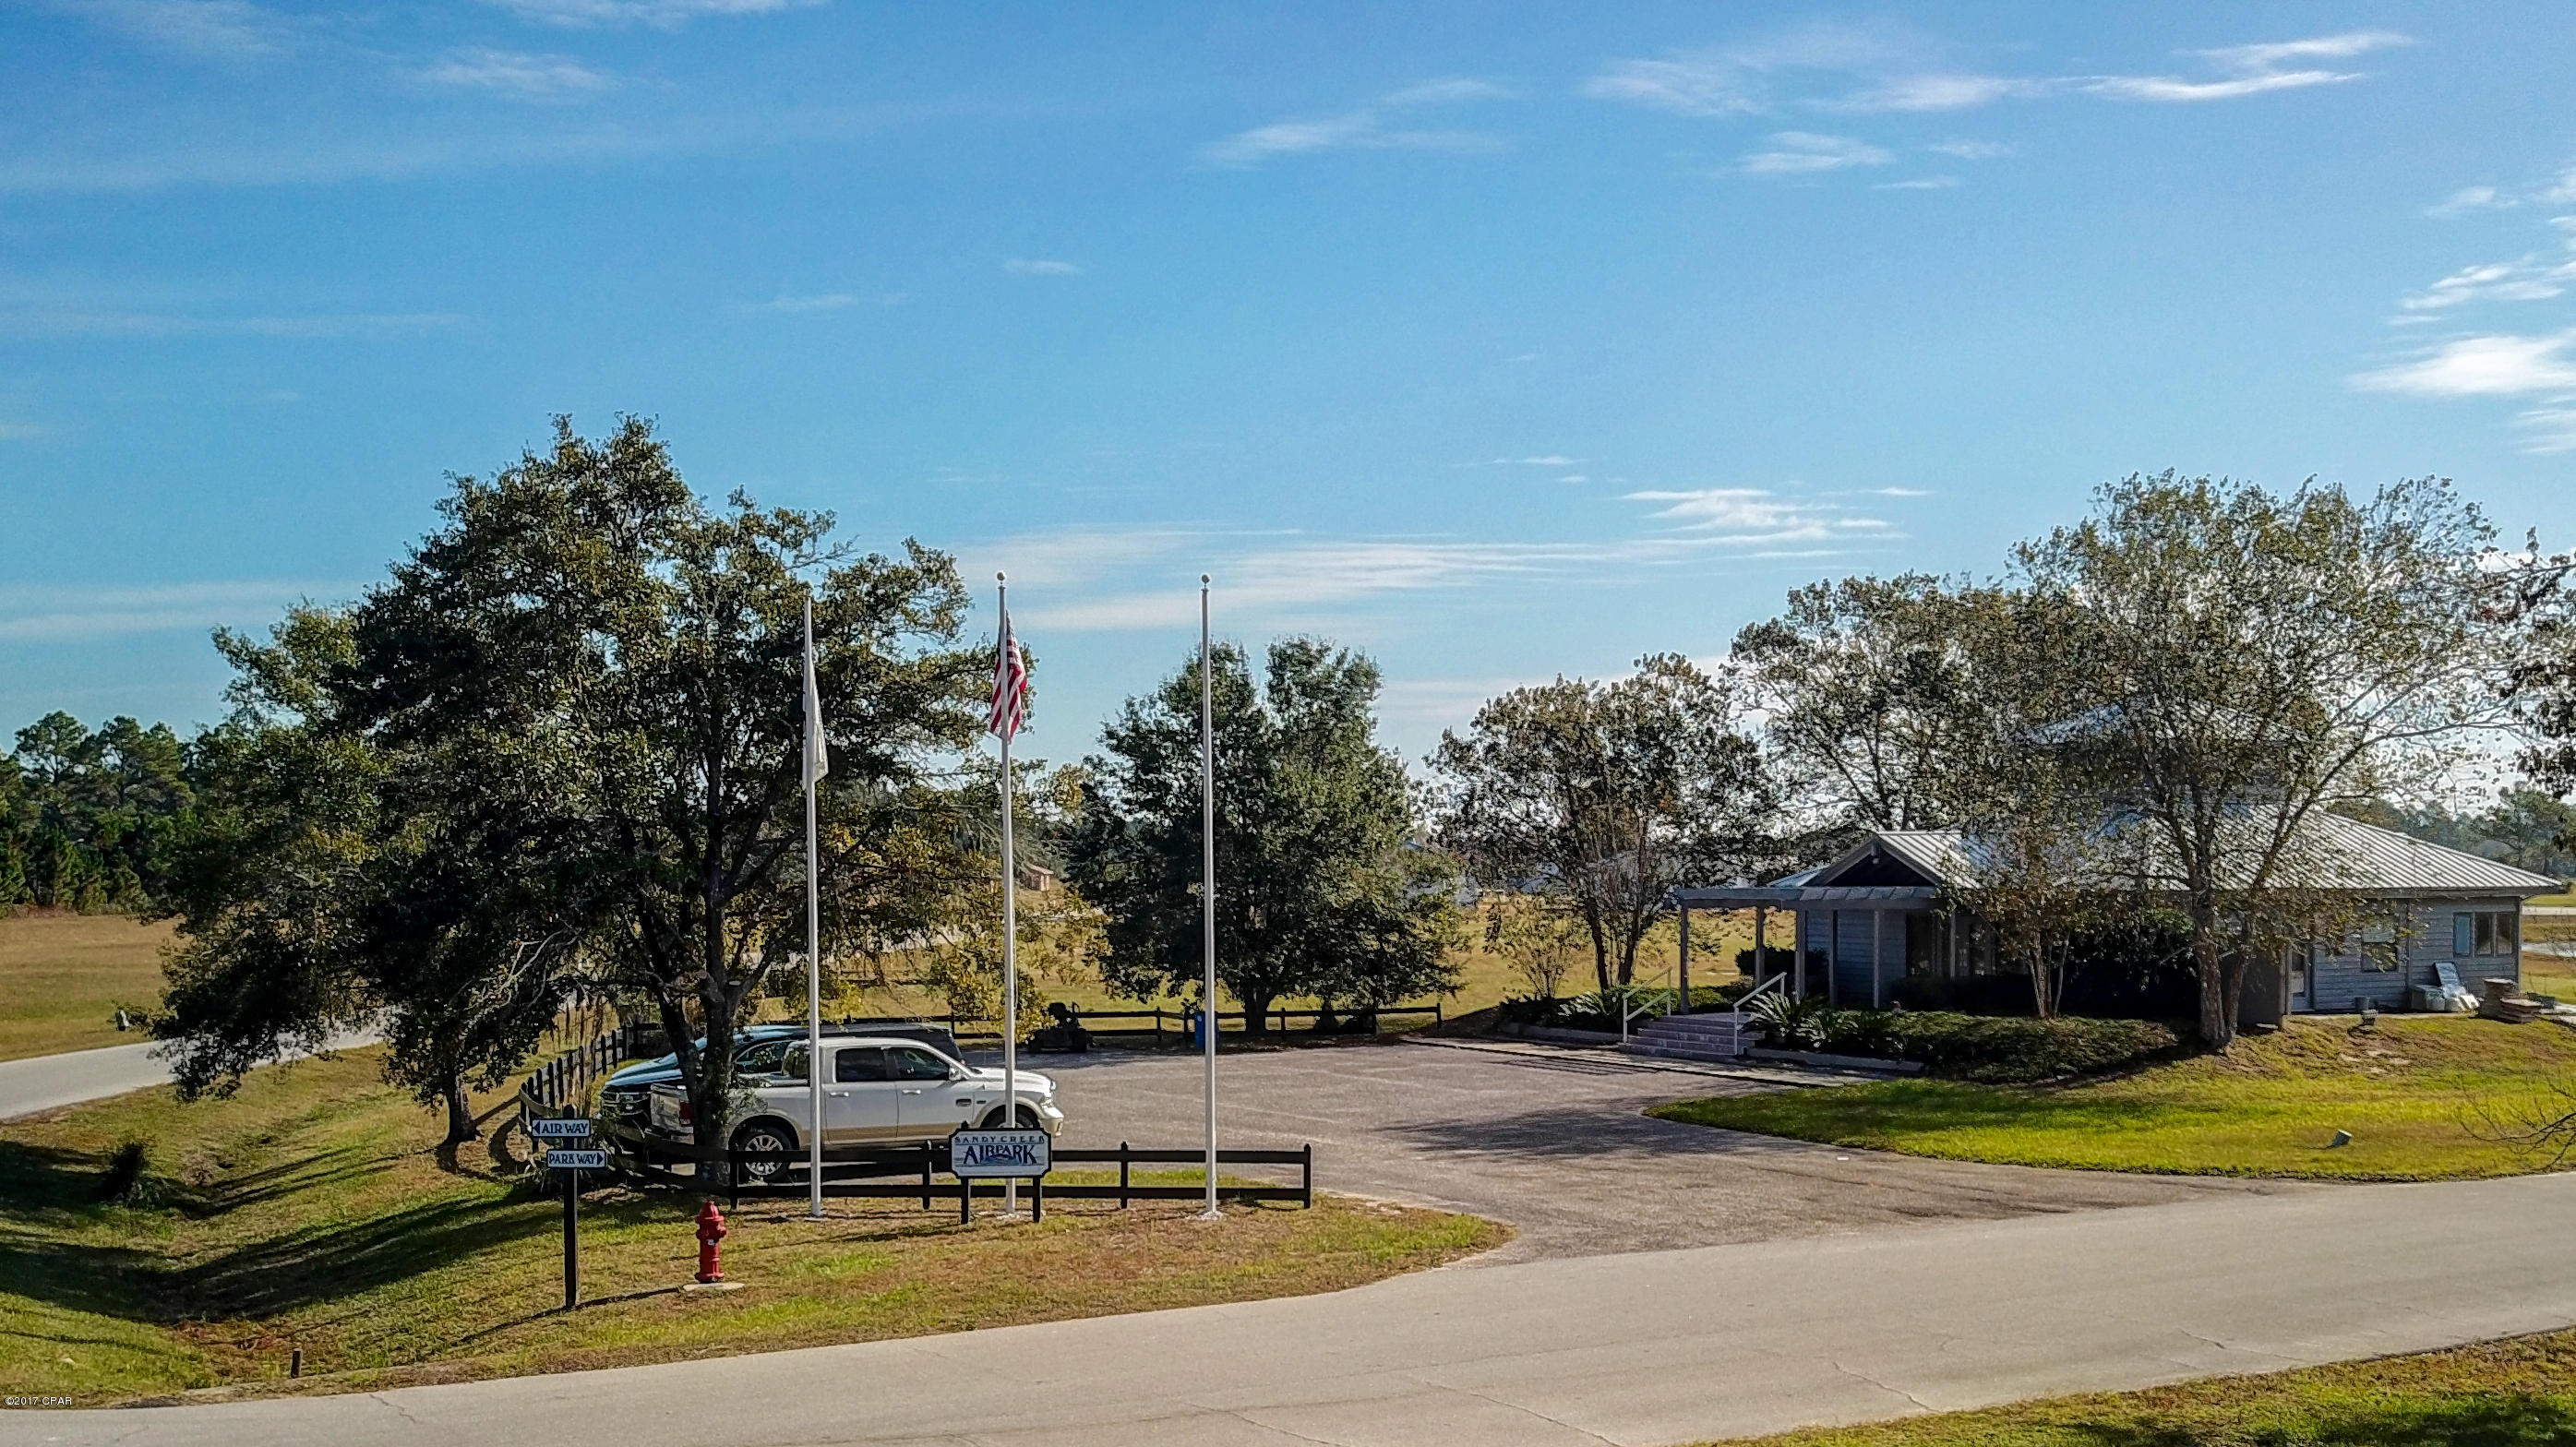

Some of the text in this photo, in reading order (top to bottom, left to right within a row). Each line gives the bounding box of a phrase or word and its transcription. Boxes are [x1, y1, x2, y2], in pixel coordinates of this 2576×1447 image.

[542, 1123, 588, 1134] AIR WAY
[954, 1135, 997, 1143] SANDY
[548, 1153, 596, 1165] PARK WAY
[963, 1144, 1037, 1165] AIRPARK
